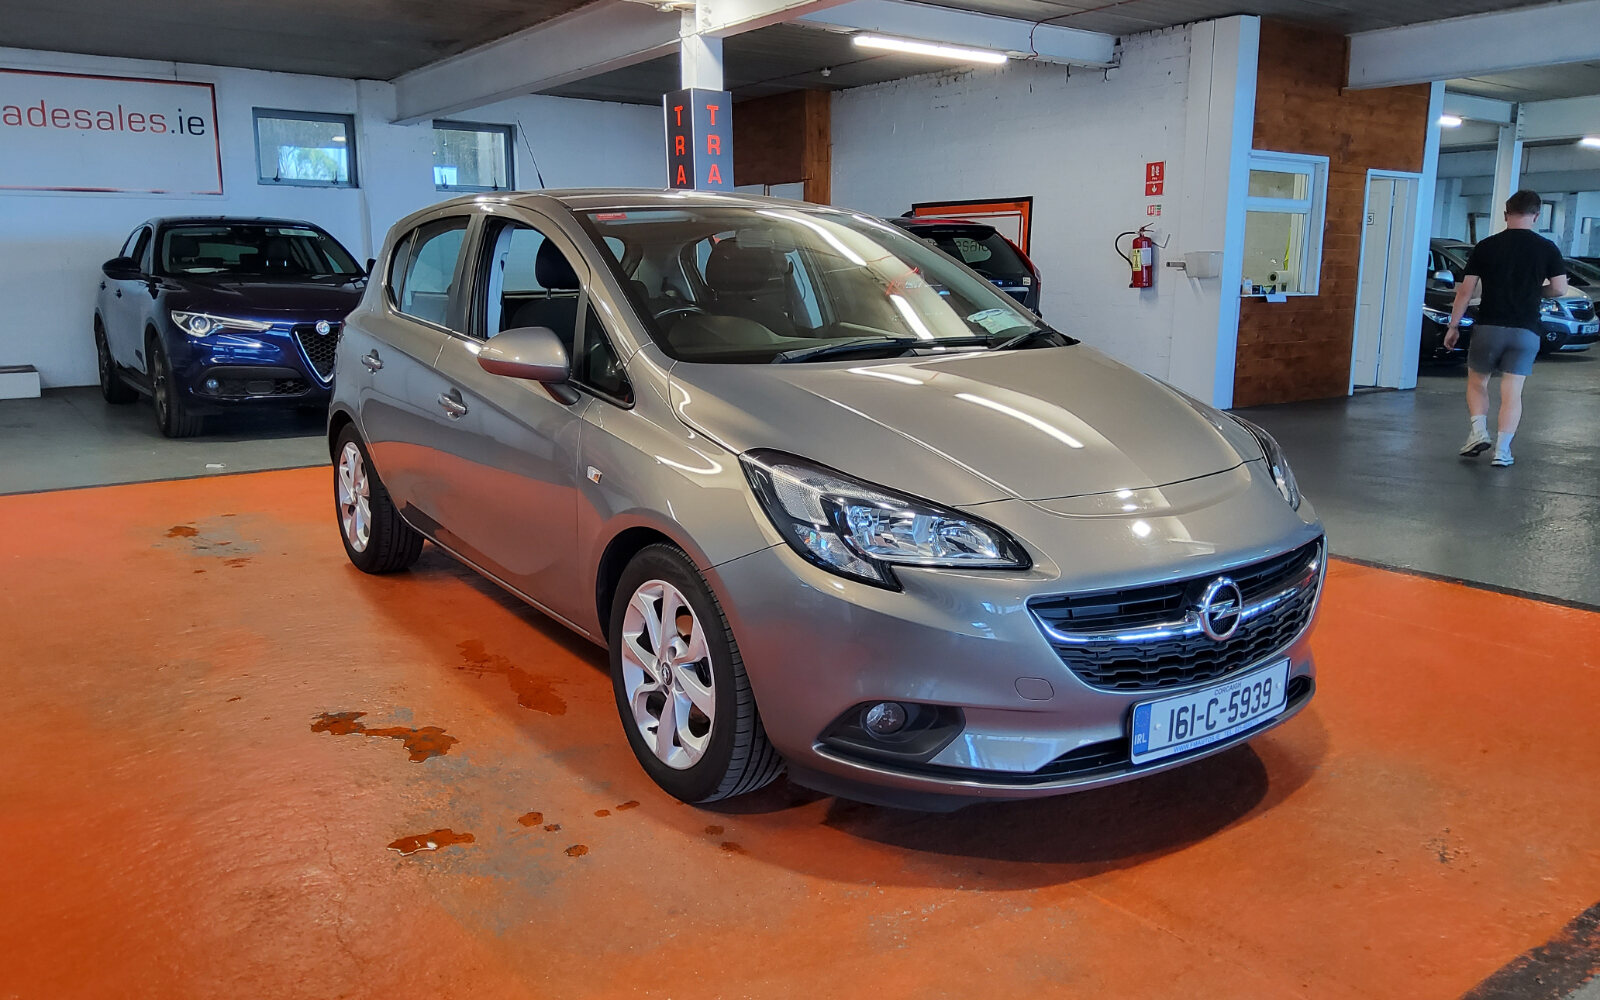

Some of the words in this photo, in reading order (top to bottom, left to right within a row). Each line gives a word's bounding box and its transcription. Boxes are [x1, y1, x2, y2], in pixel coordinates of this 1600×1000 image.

[2, 99, 205, 136] adesales.ie
[1214, 682, 1242, 696] CORCAIGH
[1168, 677, 1272, 742] 161-C-5939
[1134, 733, 1147, 746] IRL
